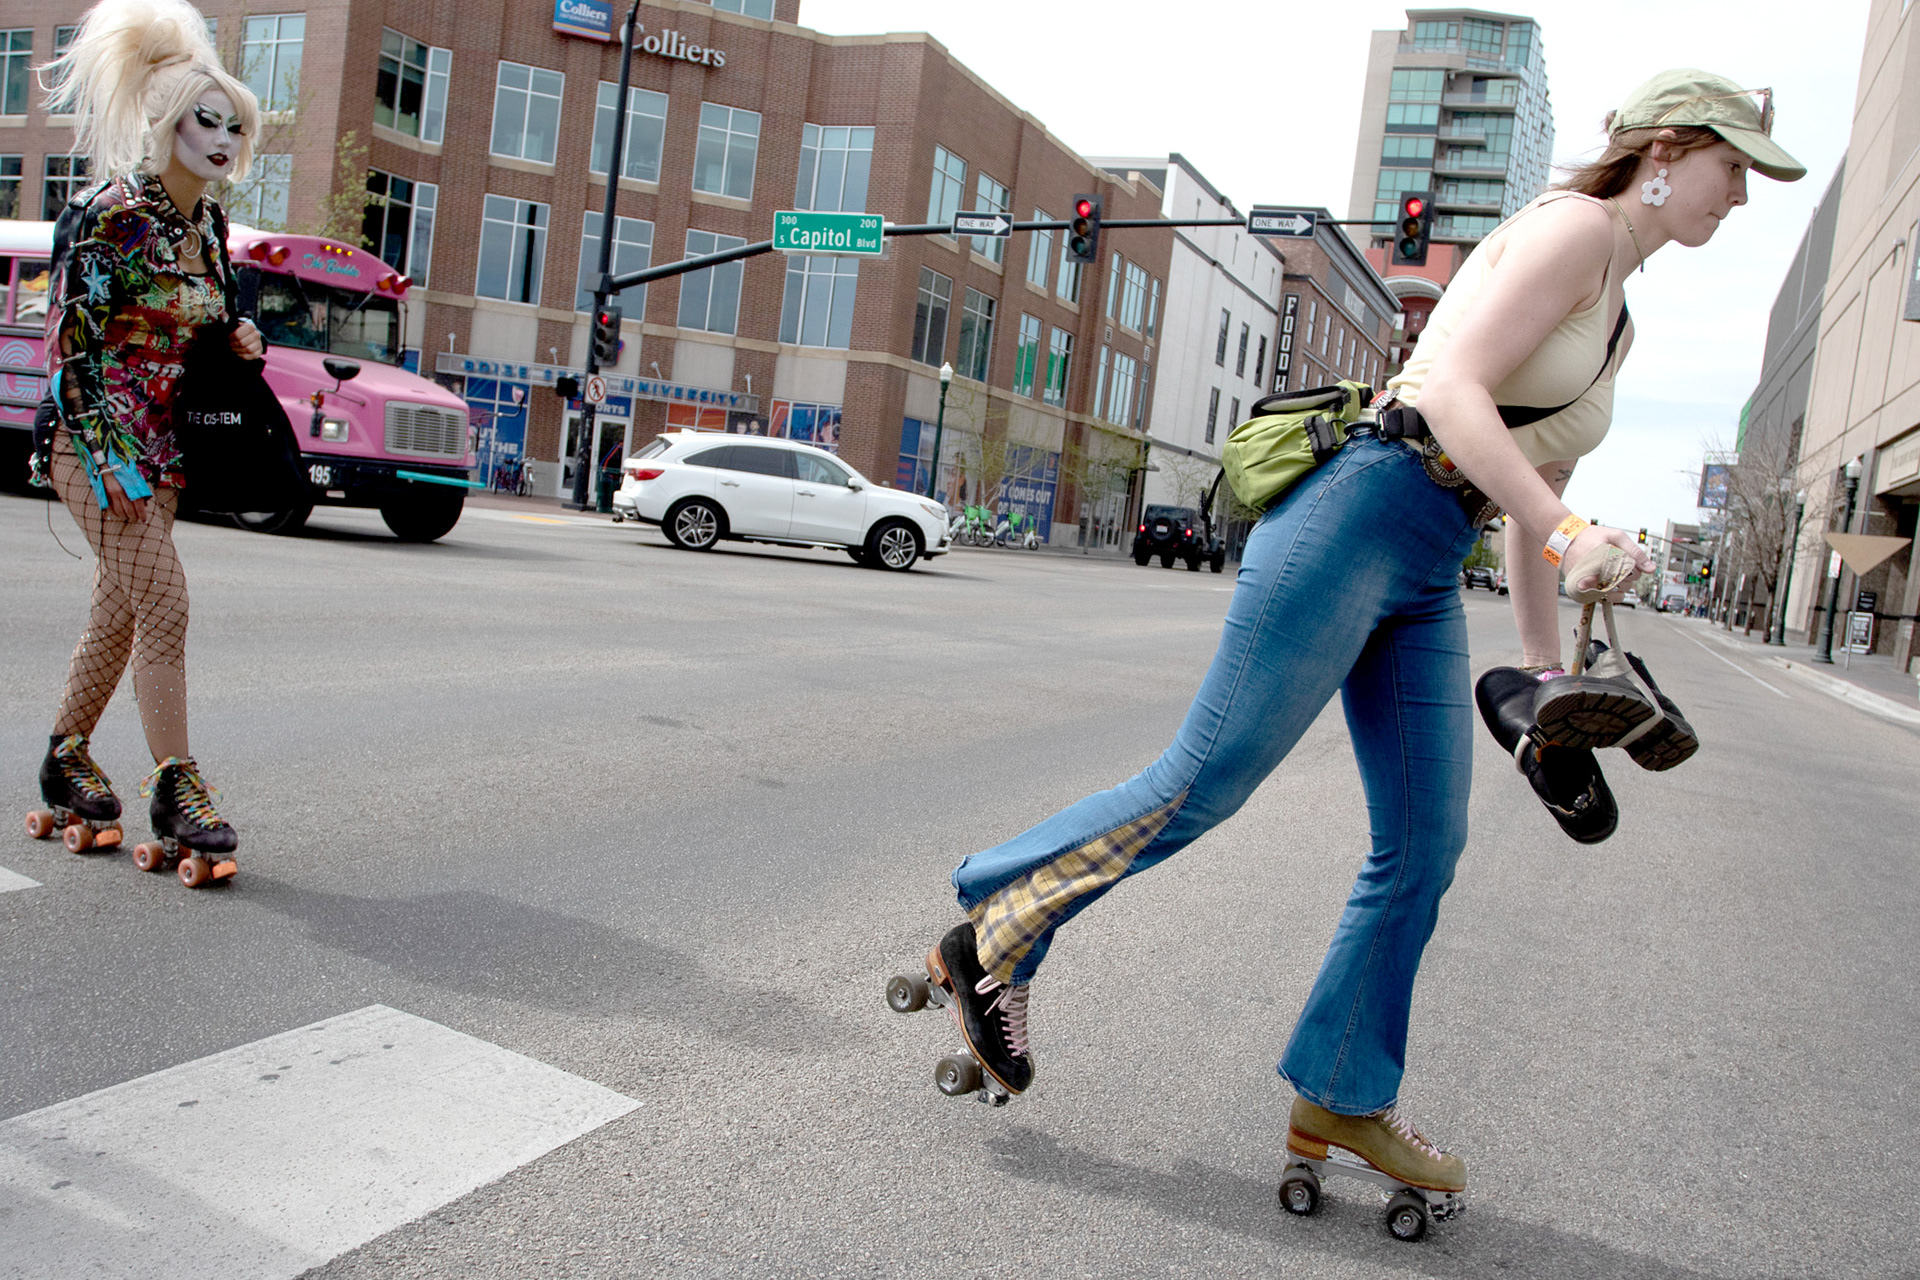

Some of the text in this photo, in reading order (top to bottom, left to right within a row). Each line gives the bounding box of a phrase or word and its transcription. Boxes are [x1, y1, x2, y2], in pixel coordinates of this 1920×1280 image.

[560, 0, 607, 21] Colliers
[619, 21, 726, 67] Colliers
[781, 215, 877, 228] 300 200
[960, 219, 995, 228] ONE WAY
[1254, 218, 1295, 228] ONE WAY
[780, 227, 876, 250] S Capitol Blvd
[302, 253, 324, 269] The
[1278, 296, 1297, 371] FOOD
[464, 360, 528, 378] BOISE
[623, 379, 739, 406] UNIVERSITY
[308, 464, 331, 485] 195
